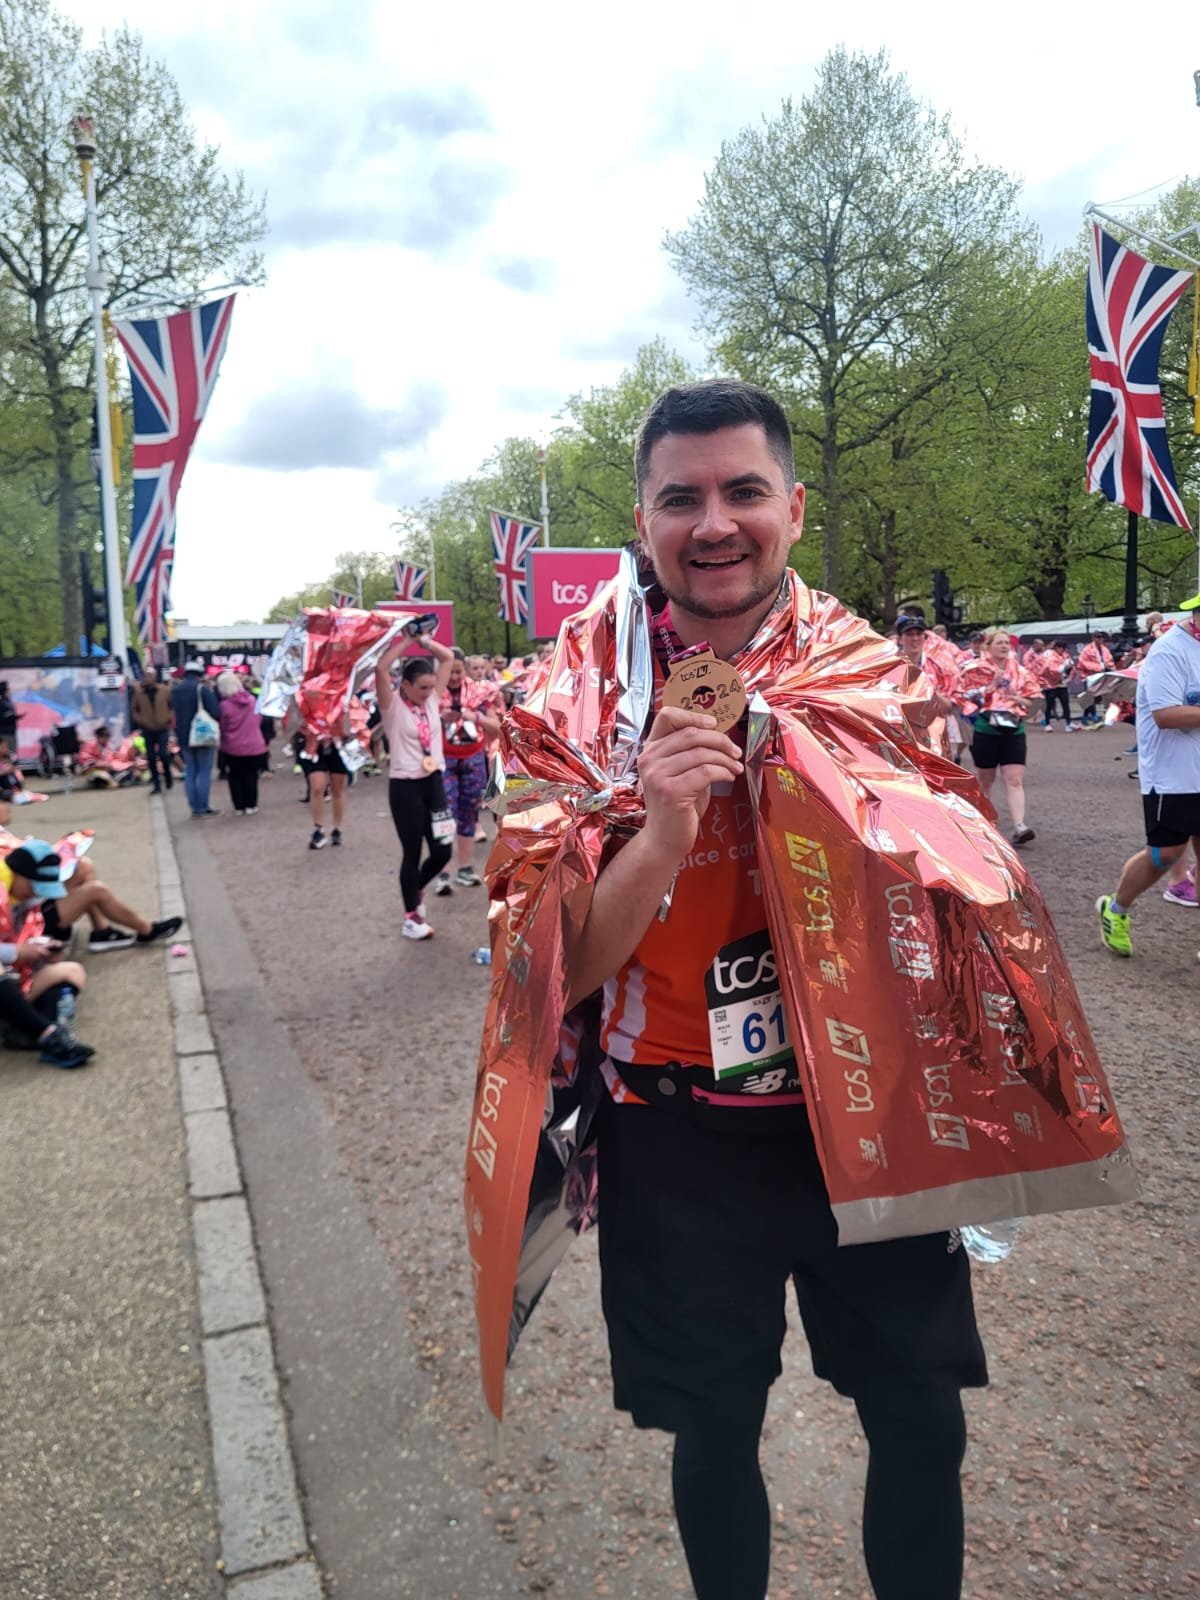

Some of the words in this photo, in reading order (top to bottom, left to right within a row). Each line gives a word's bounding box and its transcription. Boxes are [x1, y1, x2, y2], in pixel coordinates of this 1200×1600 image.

[552, 580, 588, 604] tcs
[803, 884, 834, 932] tcs
[713, 949, 778, 994] tcs
[481, 1071, 509, 1122] tcs
[844, 1068, 875, 1113] tcs
[923, 1063, 953, 1108] tcs
